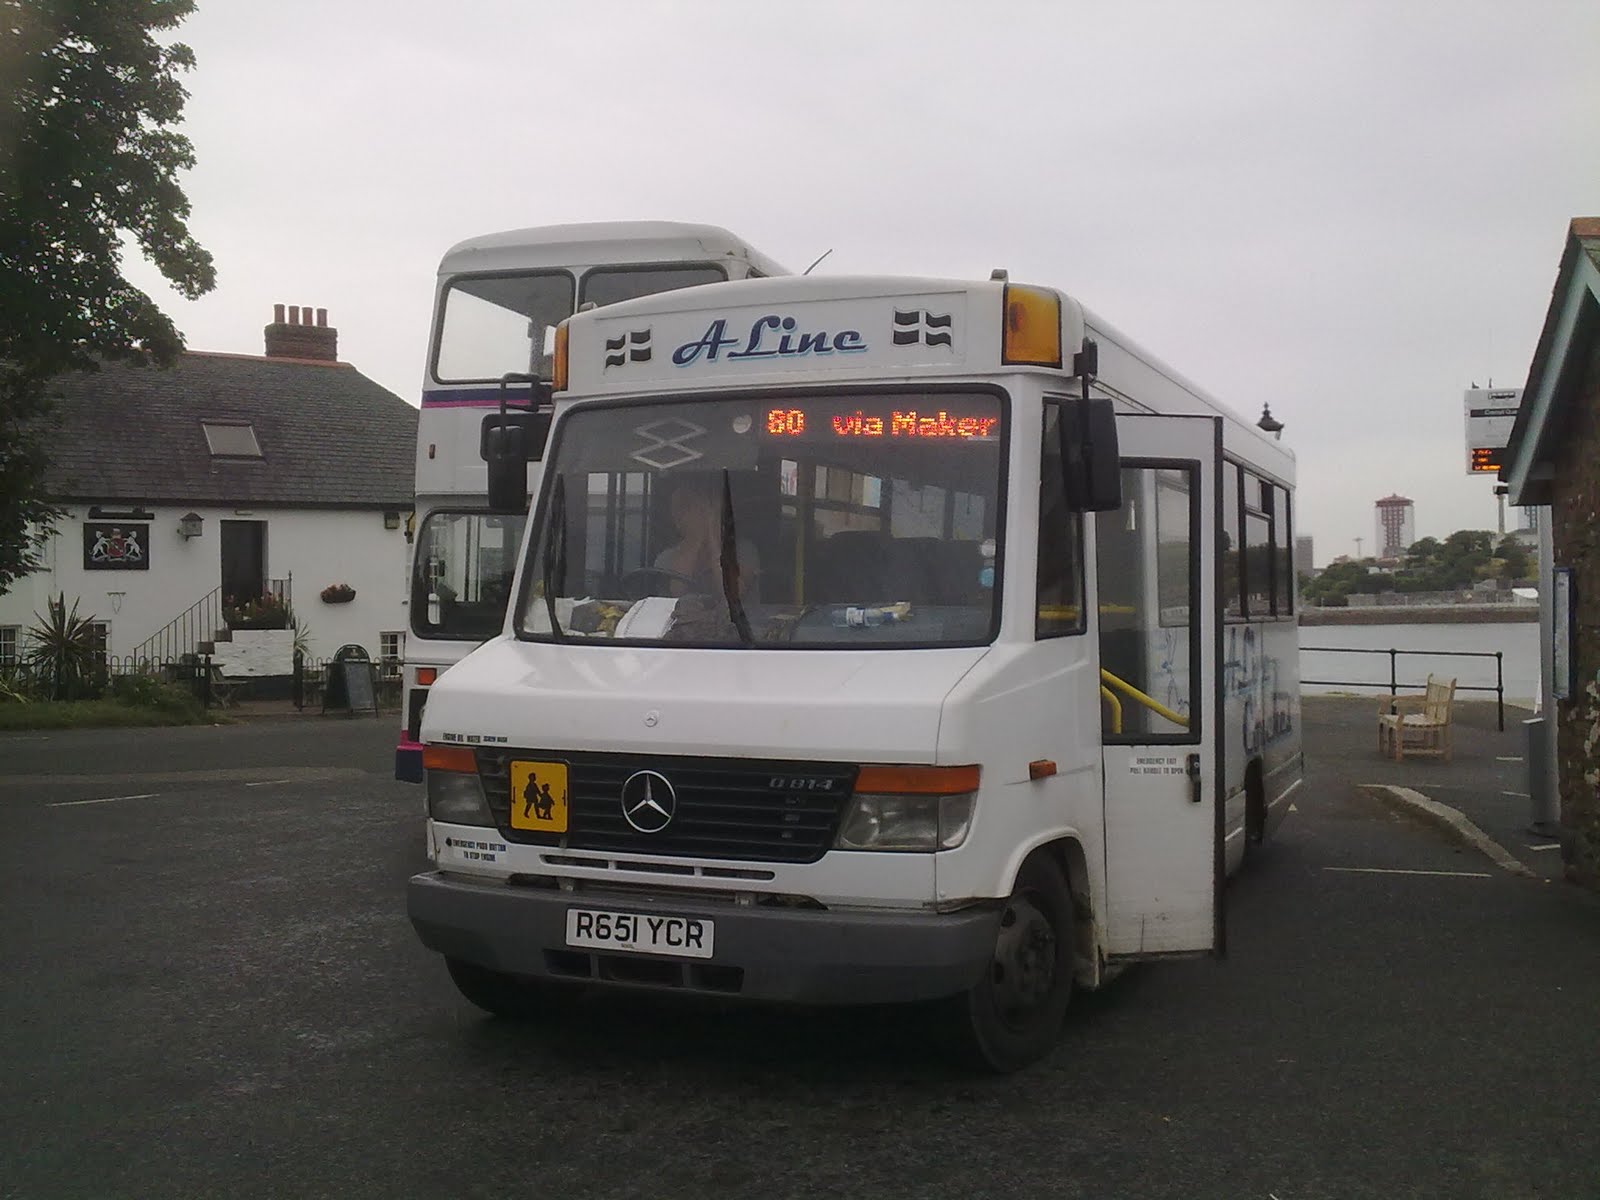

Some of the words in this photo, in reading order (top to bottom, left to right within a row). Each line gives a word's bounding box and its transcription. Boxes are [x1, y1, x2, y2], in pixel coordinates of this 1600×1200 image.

[833, 410, 884, 436] via
[891, 411, 997, 437] Maker
[576, 912, 638, 943] R651
[647, 917, 704, 949] YCR
